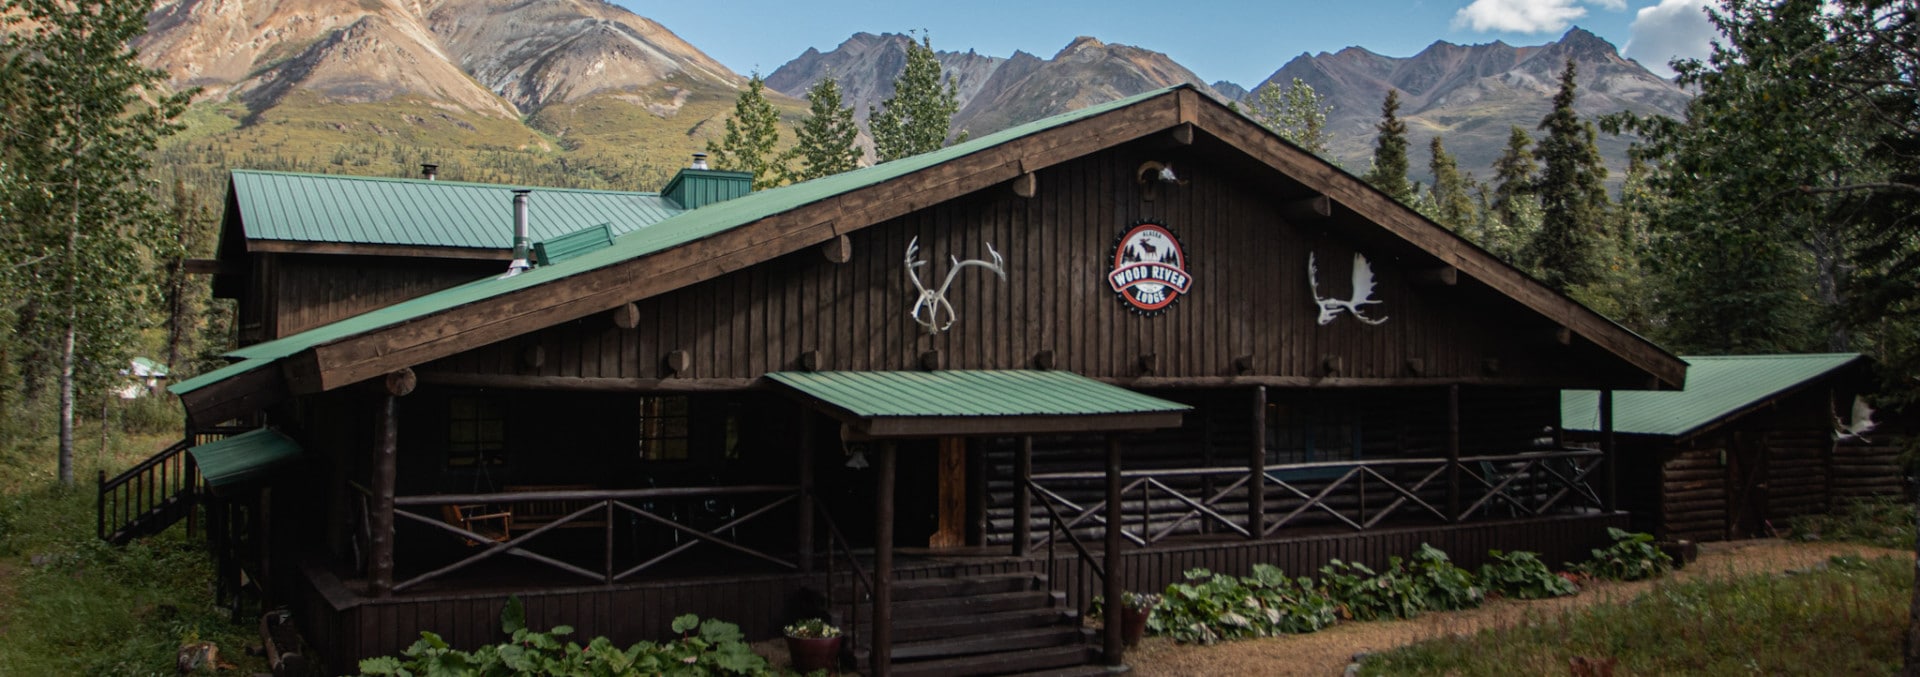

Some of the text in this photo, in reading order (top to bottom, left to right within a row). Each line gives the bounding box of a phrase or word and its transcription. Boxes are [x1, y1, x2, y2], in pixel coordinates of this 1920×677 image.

[1142, 231, 1162, 239] ALASKA
[1114, 265, 1186, 288] WOOD RIVER
[1136, 290, 1165, 304] LODGE
